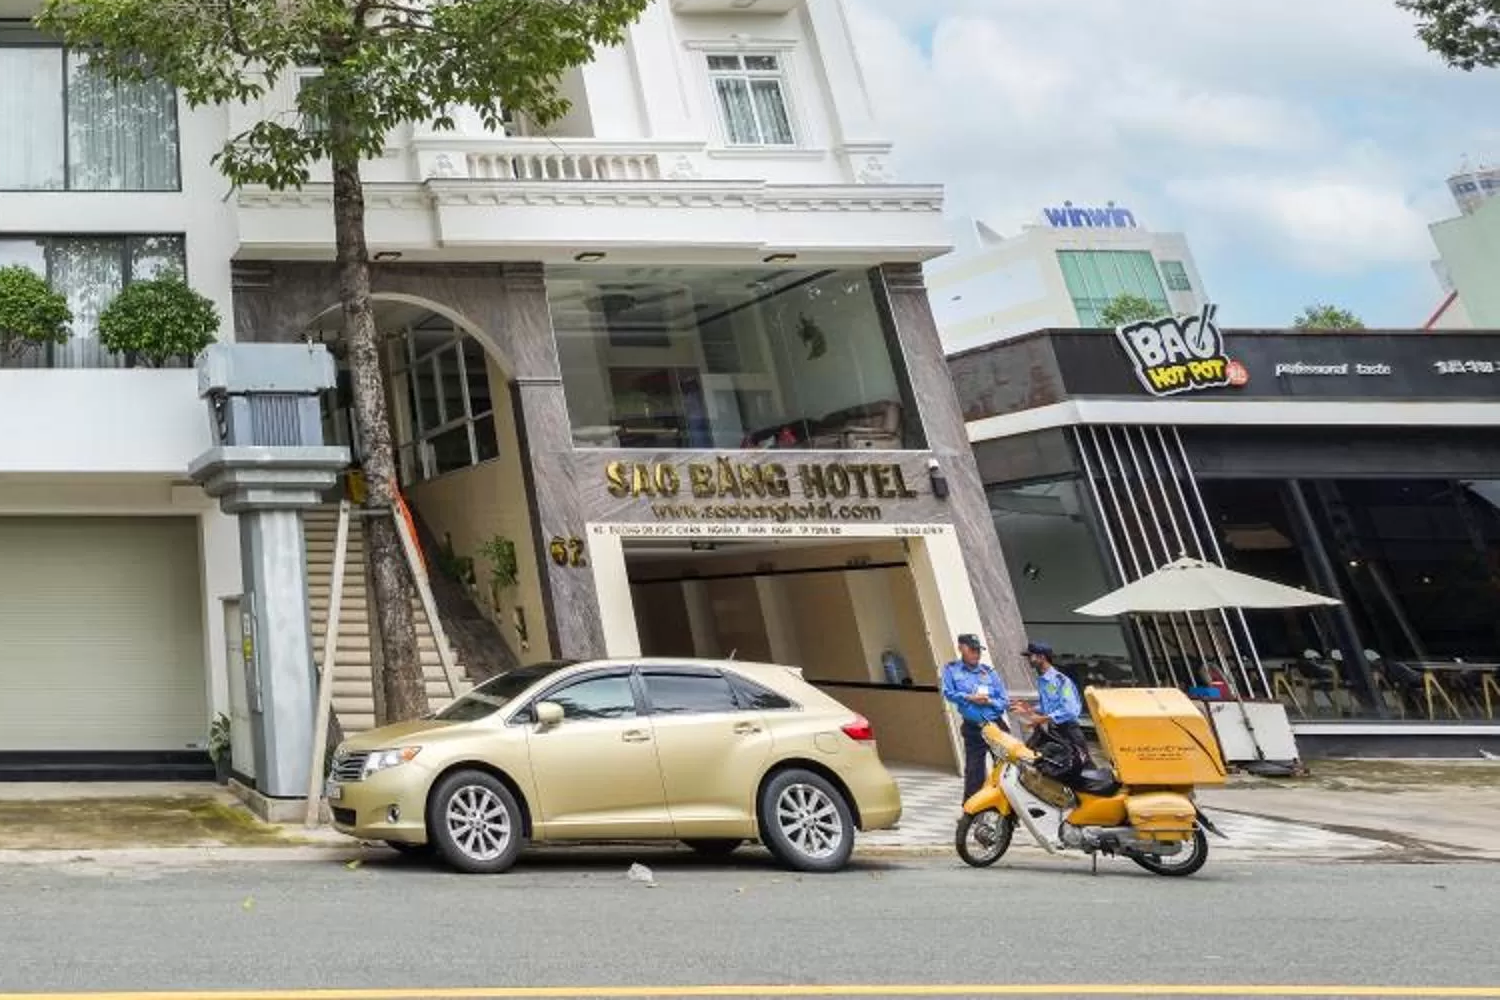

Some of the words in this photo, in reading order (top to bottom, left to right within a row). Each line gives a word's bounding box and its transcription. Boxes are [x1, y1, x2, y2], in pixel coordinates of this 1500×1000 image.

[1043, 199, 1137, 229] winwin
[1147, 366, 1188, 389] HOT
[1187, 359, 1226, 381] POT
[1356, 362, 1391, 375] taste
[605, 460, 681, 498] SAO
[798, 462, 918, 499] HOTEL
[550, 535, 587, 568] 62
